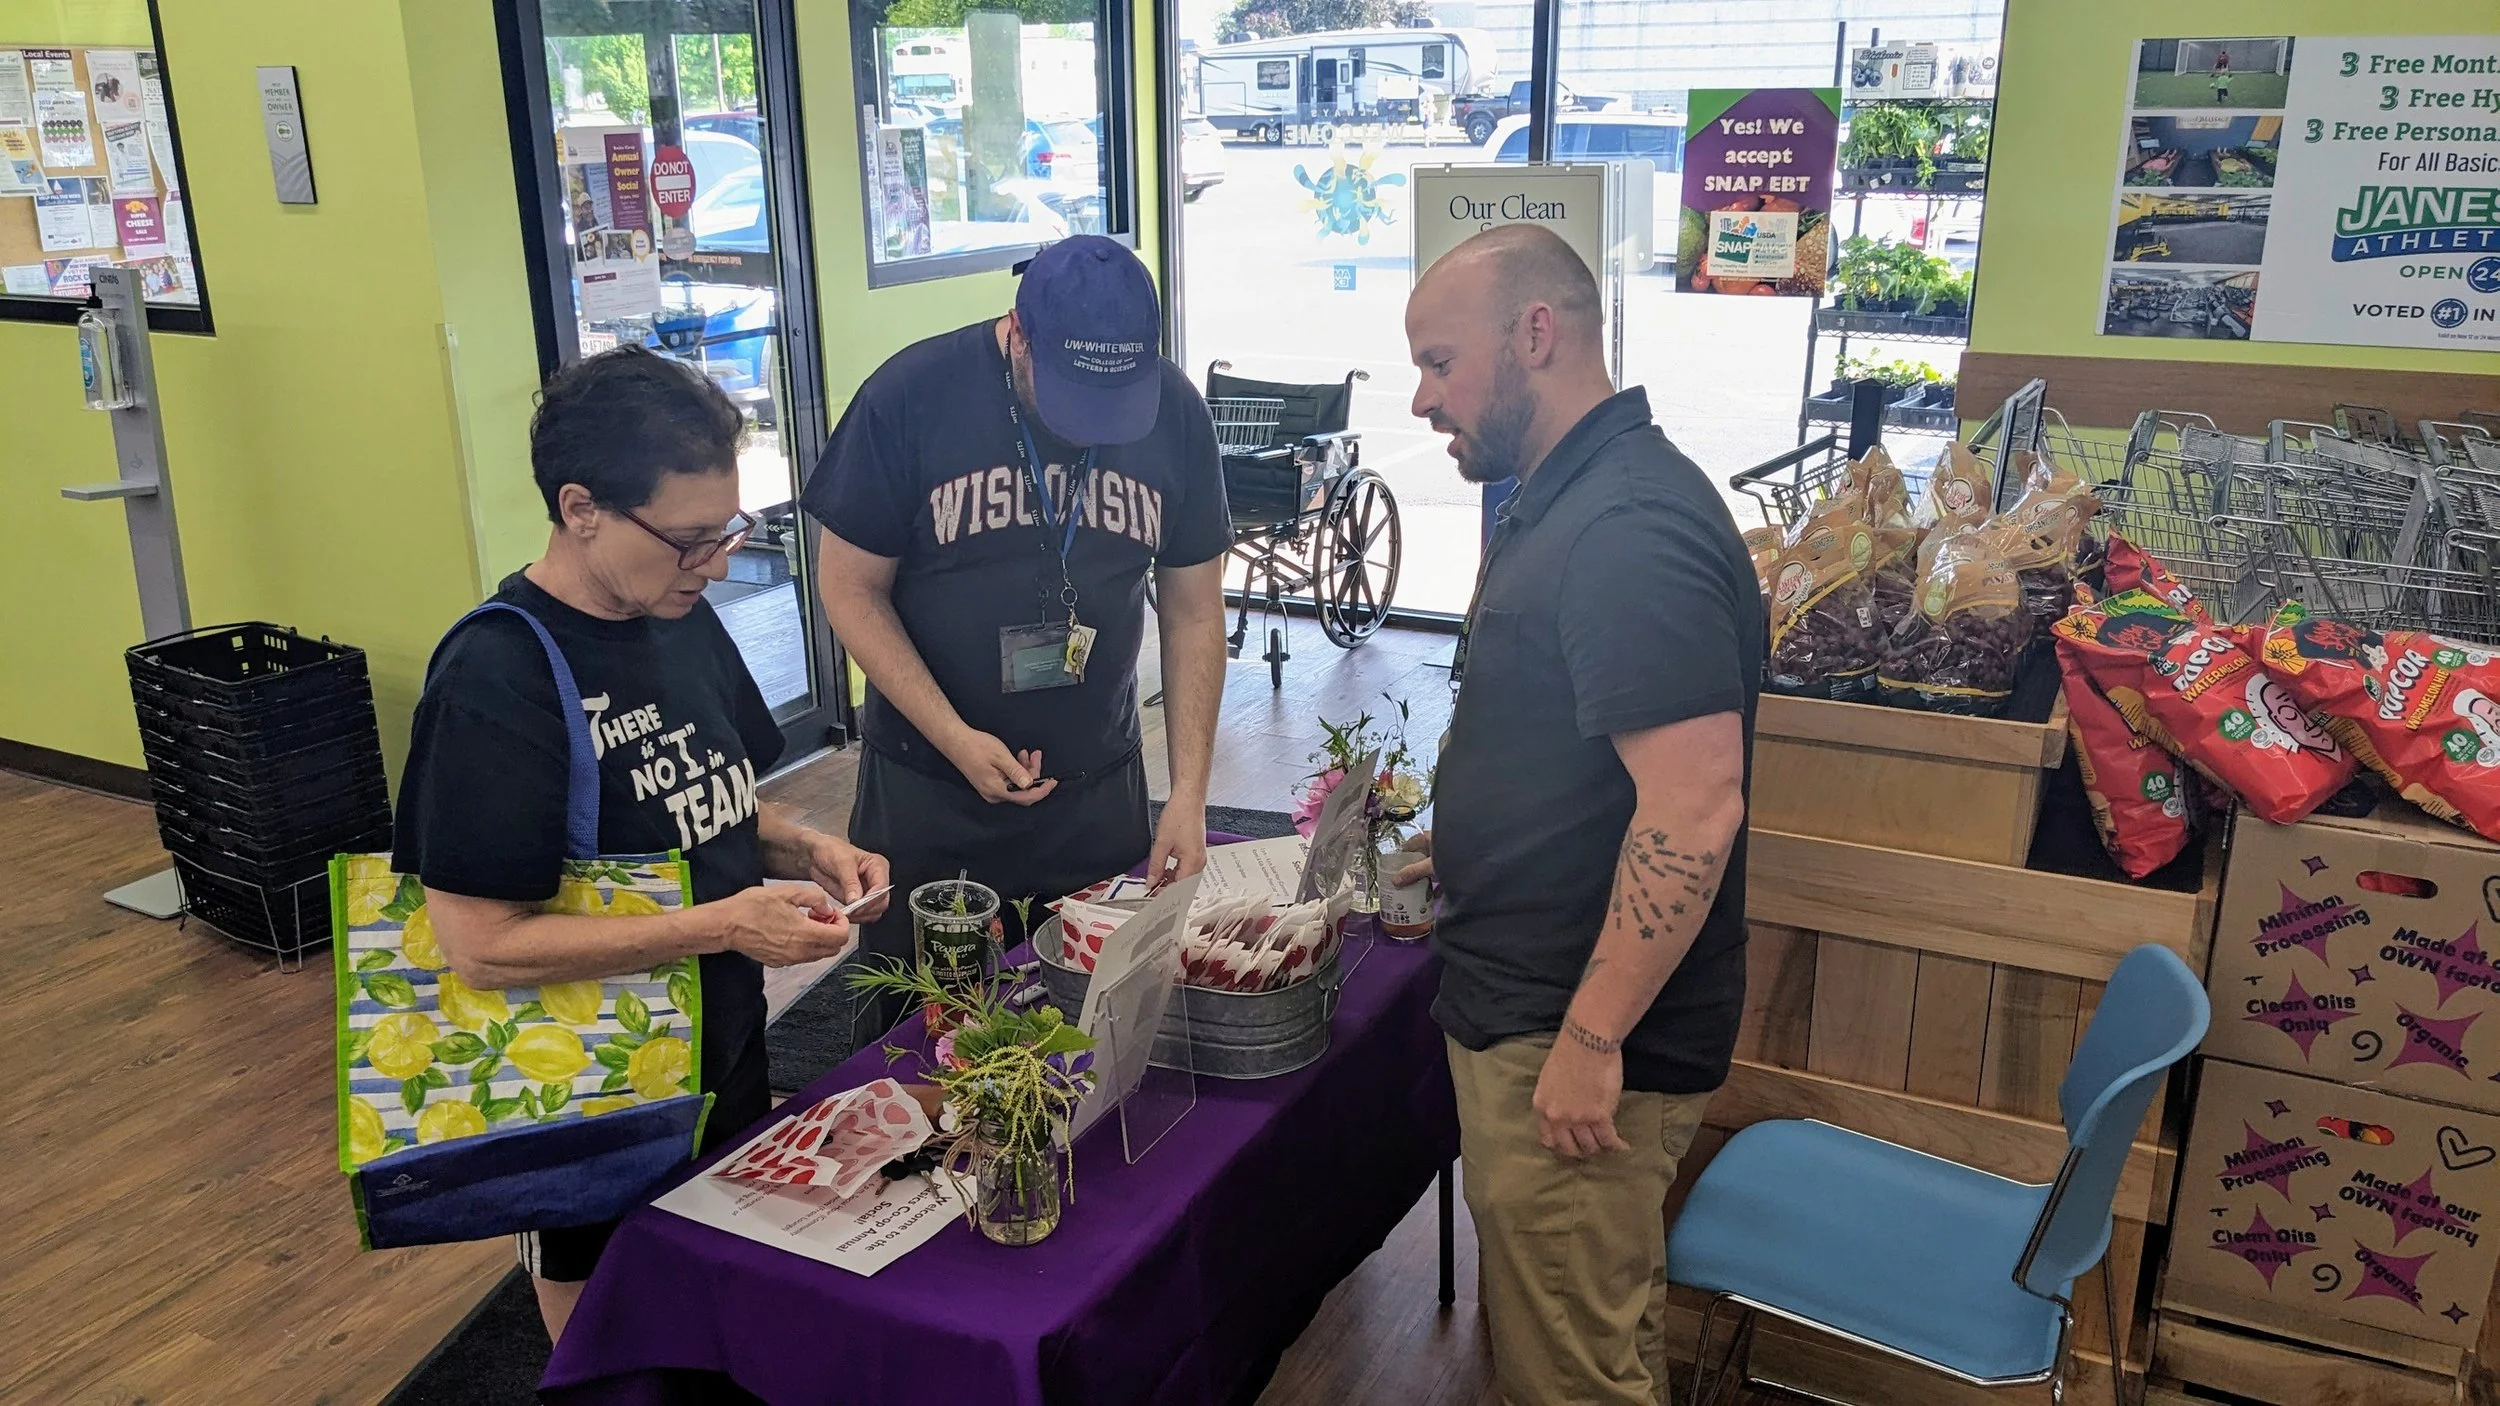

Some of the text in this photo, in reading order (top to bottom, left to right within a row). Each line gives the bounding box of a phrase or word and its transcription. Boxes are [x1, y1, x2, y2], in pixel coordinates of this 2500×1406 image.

[2340, 52, 2500, 77] 3 Free Mont
[264, 88, 290, 96] MEMBER
[2379, 85, 2399, 111] 3
[2408, 88, 2465, 107] Free
[267, 103, 293, 111] OWNER
[1720, 118, 1804, 135] Yes! We
[2305, 118, 2500, 143] 3 Free Persona
[612, 152, 639, 162] Annual
[1725, 147, 1793, 168] accept
[2378, 151, 2500, 173] For All Basic
[614, 168, 640, 176] Owner
[654, 161, 689, 176] DO NOT
[617, 181, 639, 191] Social
[1704, 176, 1810, 193] SNAP EBT
[659, 190, 691, 204] ENTER
[1450, 194, 1567, 220] Our Clean
[2340, 187, 2500, 232] JANE
[126, 219, 154, 228] CHEESE
[1716, 241, 1751, 254] SNAP
[2351, 230, 2494, 255] ATHLET
[63, 275, 83, 283] ROCK
[2399, 265, 2464, 280] OPEN
[2353, 304, 2495, 322] VOTED #1 IN
[1064, 339, 1144, 354] UW-WHITEWATER
[1073, 359, 1103, 372] LETTERS
[1091, 357, 1115, 365] COLLEGE
[930, 464, 1163, 553] WISCONSIN
[2182, 656, 2250, 702] WATERMELON
[2224, 711, 2244, 732] 40
[640, 738, 656, 759] is
[2447, 733, 2468, 753] 40
[630, 722, 726, 801] NO "I" in
[2146, 775, 2166, 792] 40
[664, 757, 759, 852] TEAM
[2258, 894, 2344, 933] Minimal
[2254, 909, 2371, 957] Processing
[930, 940, 976, 953] Panera
[2392, 926, 2456, 957] Made
[2462, 948, 2487, 966] at
[2379, 945, 2441, 976] OWN
[2246, 994, 2356, 1015] Clean Oils
[2279, 1018, 2330, 1036] Only
[2396, 1012, 2469, 1069] Organic
[2223, 1136, 2305, 1169] Minimal
[2220, 1151, 2331, 1192] Processing
[2351, 1169, 2482, 1224] Made at our
[854, 1200, 892, 1226] Social!
[864, 1194, 952, 1253] Welcome to the
[876, 1206, 911, 1229] Co-op
[2338, 1186, 2480, 1248] OWN factory
[837, 1228, 877, 1253] Annual
[2212, 1228, 2316, 1244] Clean Oils
[2245, 1249, 2292, 1267] Only
[2354, 1247, 2423, 1302] Organic
